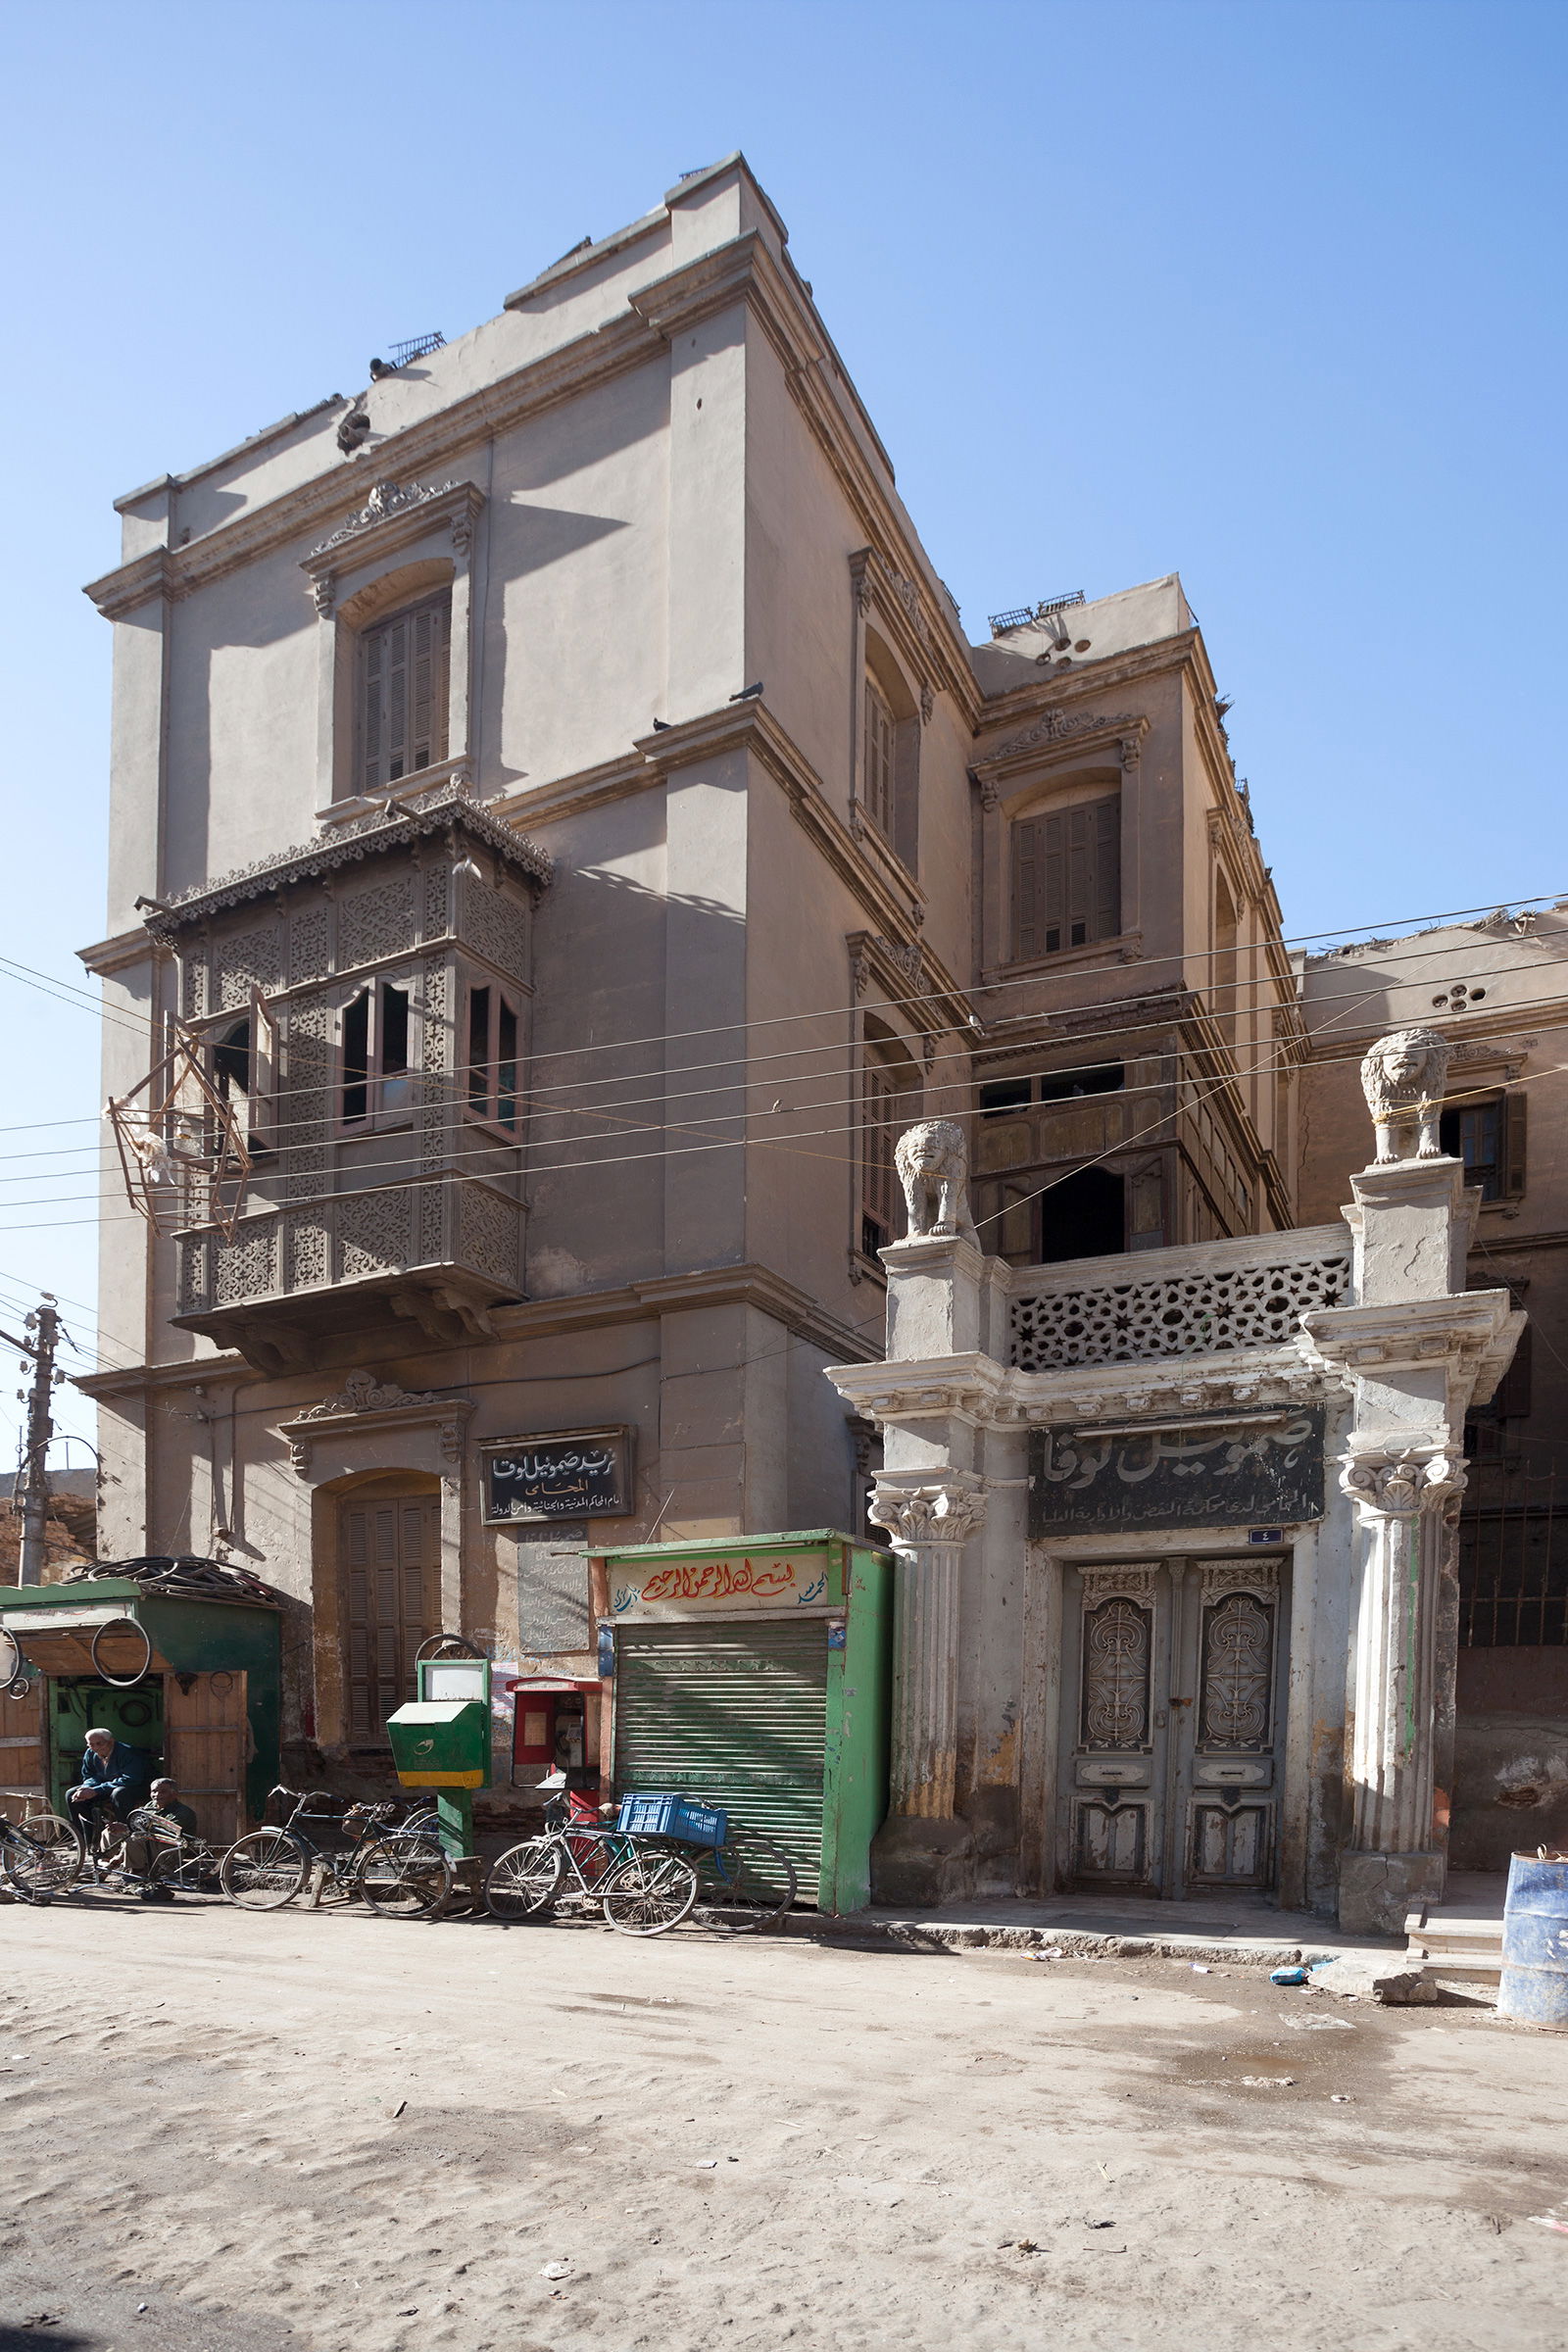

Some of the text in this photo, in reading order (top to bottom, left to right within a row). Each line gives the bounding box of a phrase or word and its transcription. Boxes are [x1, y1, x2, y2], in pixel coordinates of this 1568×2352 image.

[493, 1454, 527, 1480] لوقا
[1043, 1432, 1113, 1489] لوقا
[564, 1497, 588, 1510] المدنية
[588, 1494, 608, 1511] المحاكم
[1262, 1531, 1270, 1542] ٤
[751, 1562, 796, 1597] بسم
